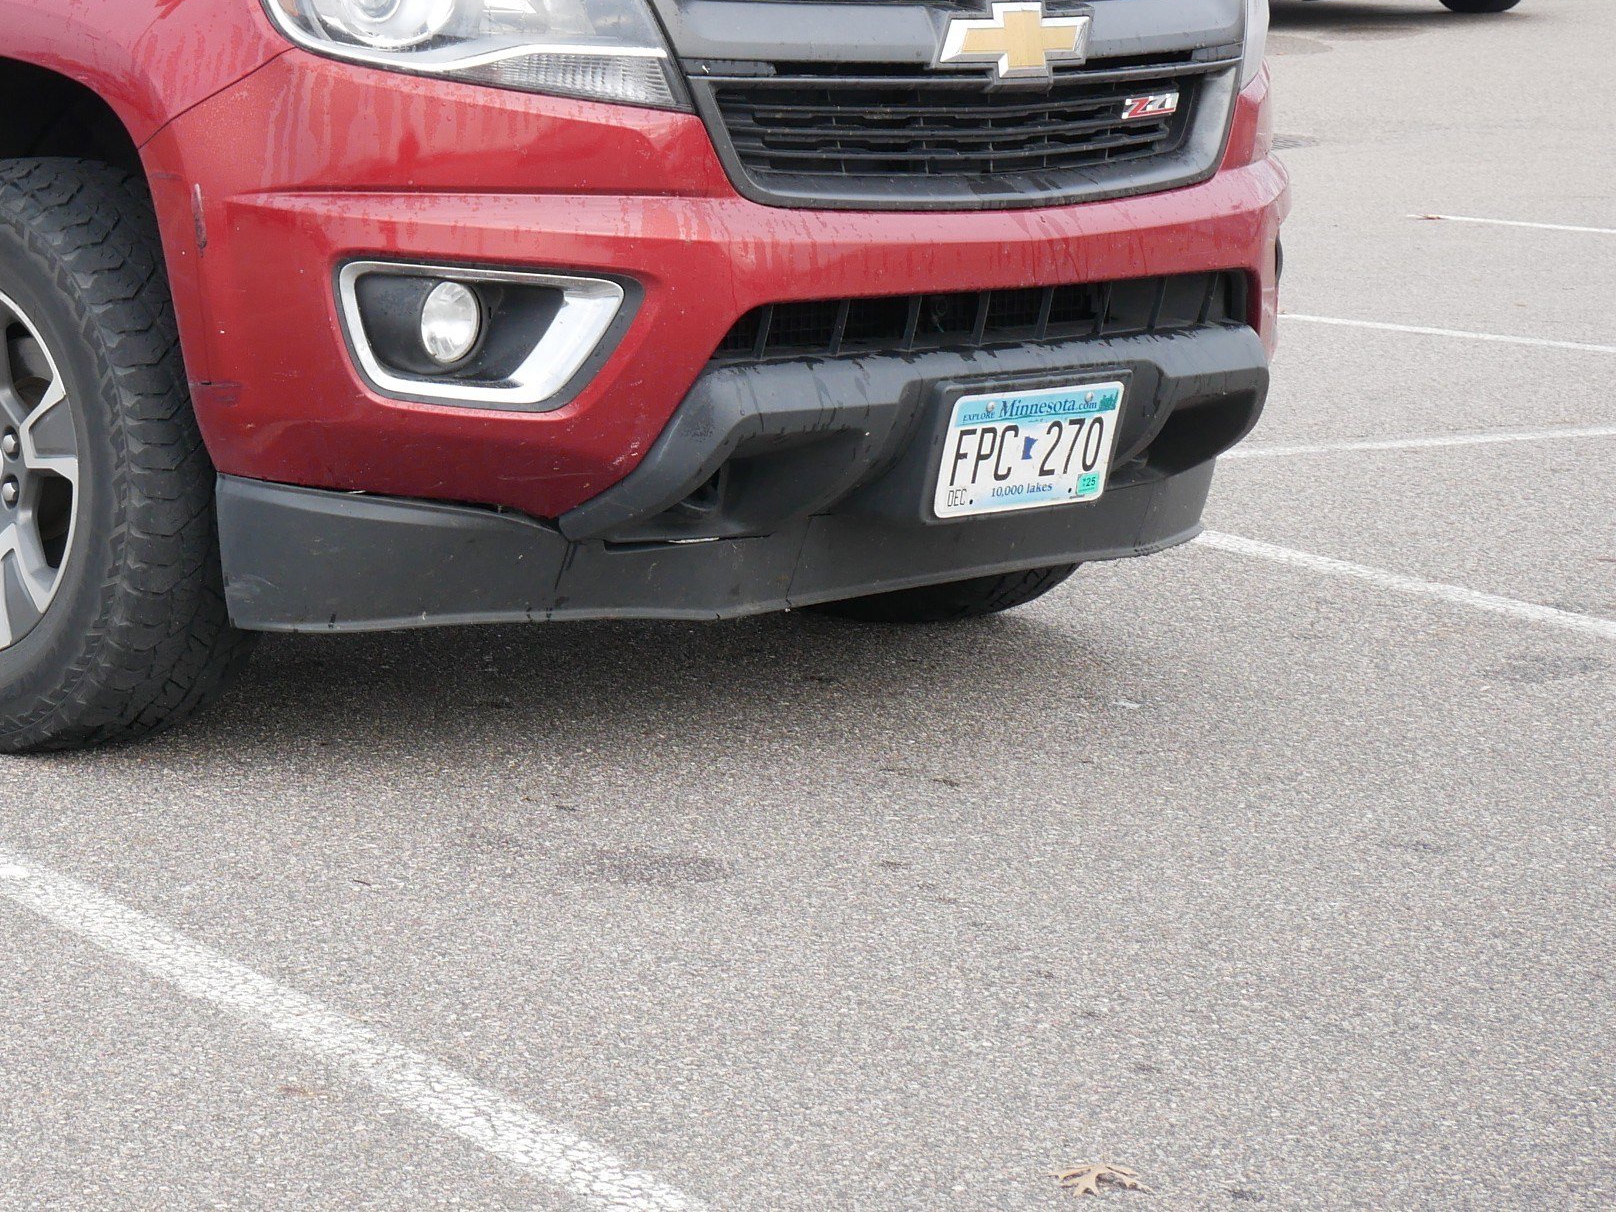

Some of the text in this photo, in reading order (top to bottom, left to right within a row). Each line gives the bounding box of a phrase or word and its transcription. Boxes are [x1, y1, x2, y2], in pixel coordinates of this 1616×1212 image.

[1122, 92, 1179, 119] Z71
[998, 399, 1098, 419] Minnesota.com
[949, 416, 1105, 486] FPC 270
[991, 482, 1054, 498] 10,000 lakes
[1086, 476, 1096, 487] 25
[947, 488, 968, 507] DEC
